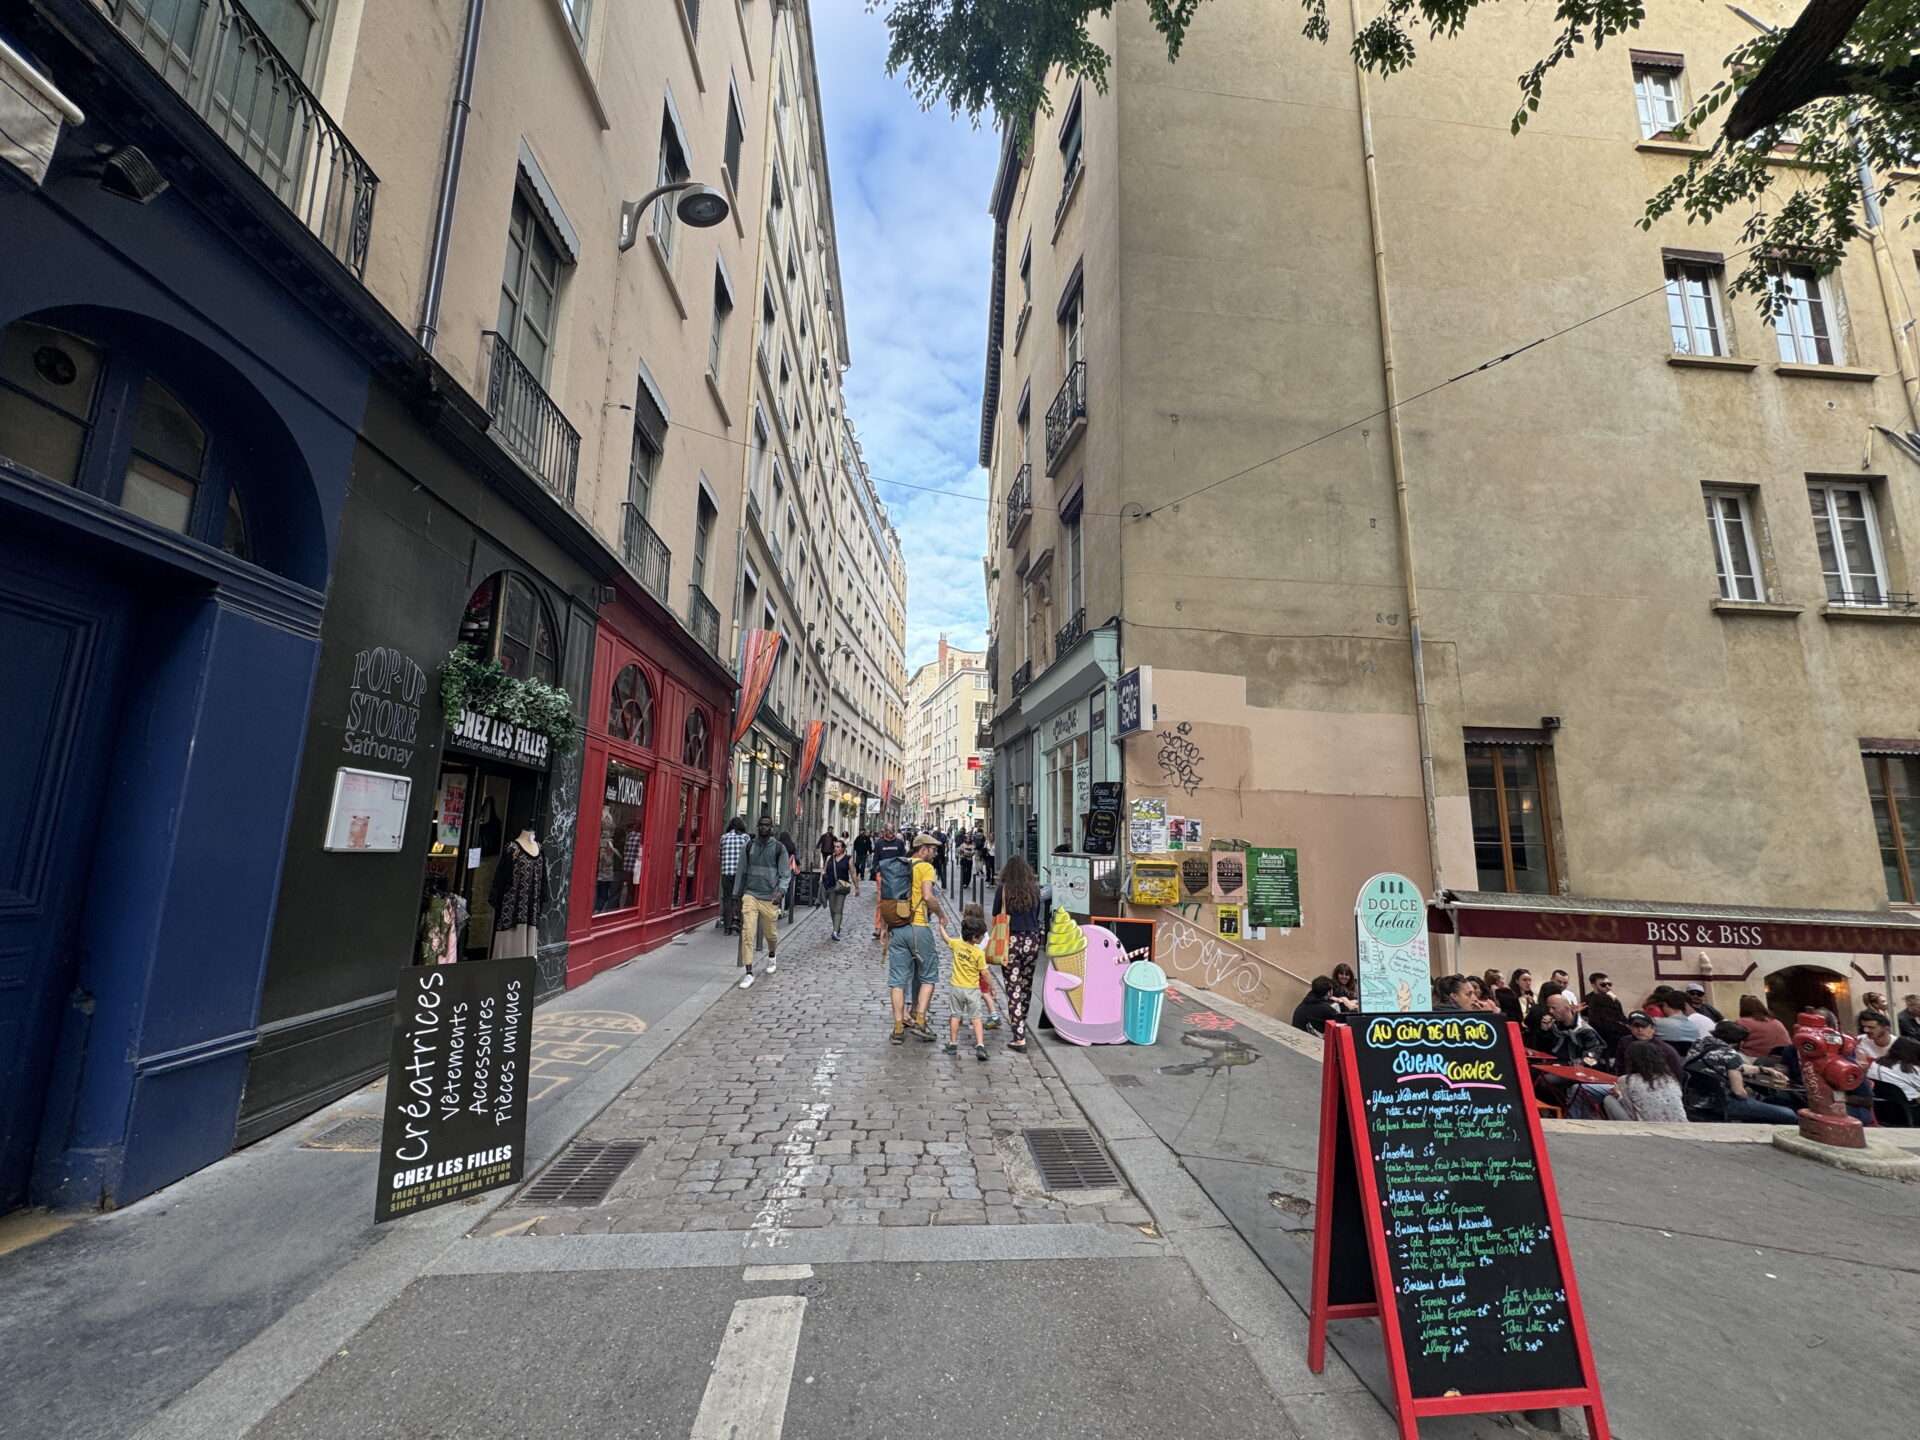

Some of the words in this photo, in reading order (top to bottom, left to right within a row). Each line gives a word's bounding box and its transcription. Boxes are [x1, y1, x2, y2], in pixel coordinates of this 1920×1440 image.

[346, 691, 421, 744] STORE
[453, 708, 491, 744] CHEZ
[491, 720, 514, 749] LES
[514, 727, 549, 759] FILLES
[342, 731, 414, 769] Sathonay
[618, 775, 643, 806] YUKAKO
[1368, 898, 1418, 912] DOLCE
[1373, 910, 1417, 929] Gelati
[1695, 924, 1714, 944] &
[499, 979, 522, 1054] uniques
[1372, 1023, 1392, 1043] AU
[1426, 1023, 1444, 1041] DE
[1446, 1023, 1461, 1041] LA
[1465, 1023, 1489, 1042] RUE
[396, 971, 444, 1162] Créatrices
[441, 1001, 468, 1121] Vêtements
[468, 996, 495, 1116] Accessoires
[1392, 1050, 1447, 1075] SUGAR
[1447, 1059, 1502, 1081] CORNER
[495, 1059, 515, 1126] Pièces
[391, 1184, 426, 1202] FRENCH
[429, 1171, 475, 1194] HANDMADE
[477, 1162, 512, 1181] FASHION
[392, 1165, 434, 1190] CHEZ
[437, 1156, 464, 1179] LES
[467, 1144, 513, 1170] FILLES
[390, 1196, 417, 1213] SINCE
[447, 1185, 458, 1199] BY
[461, 1178, 483, 1194] MINA
[486, 1174, 496, 1188] ET
